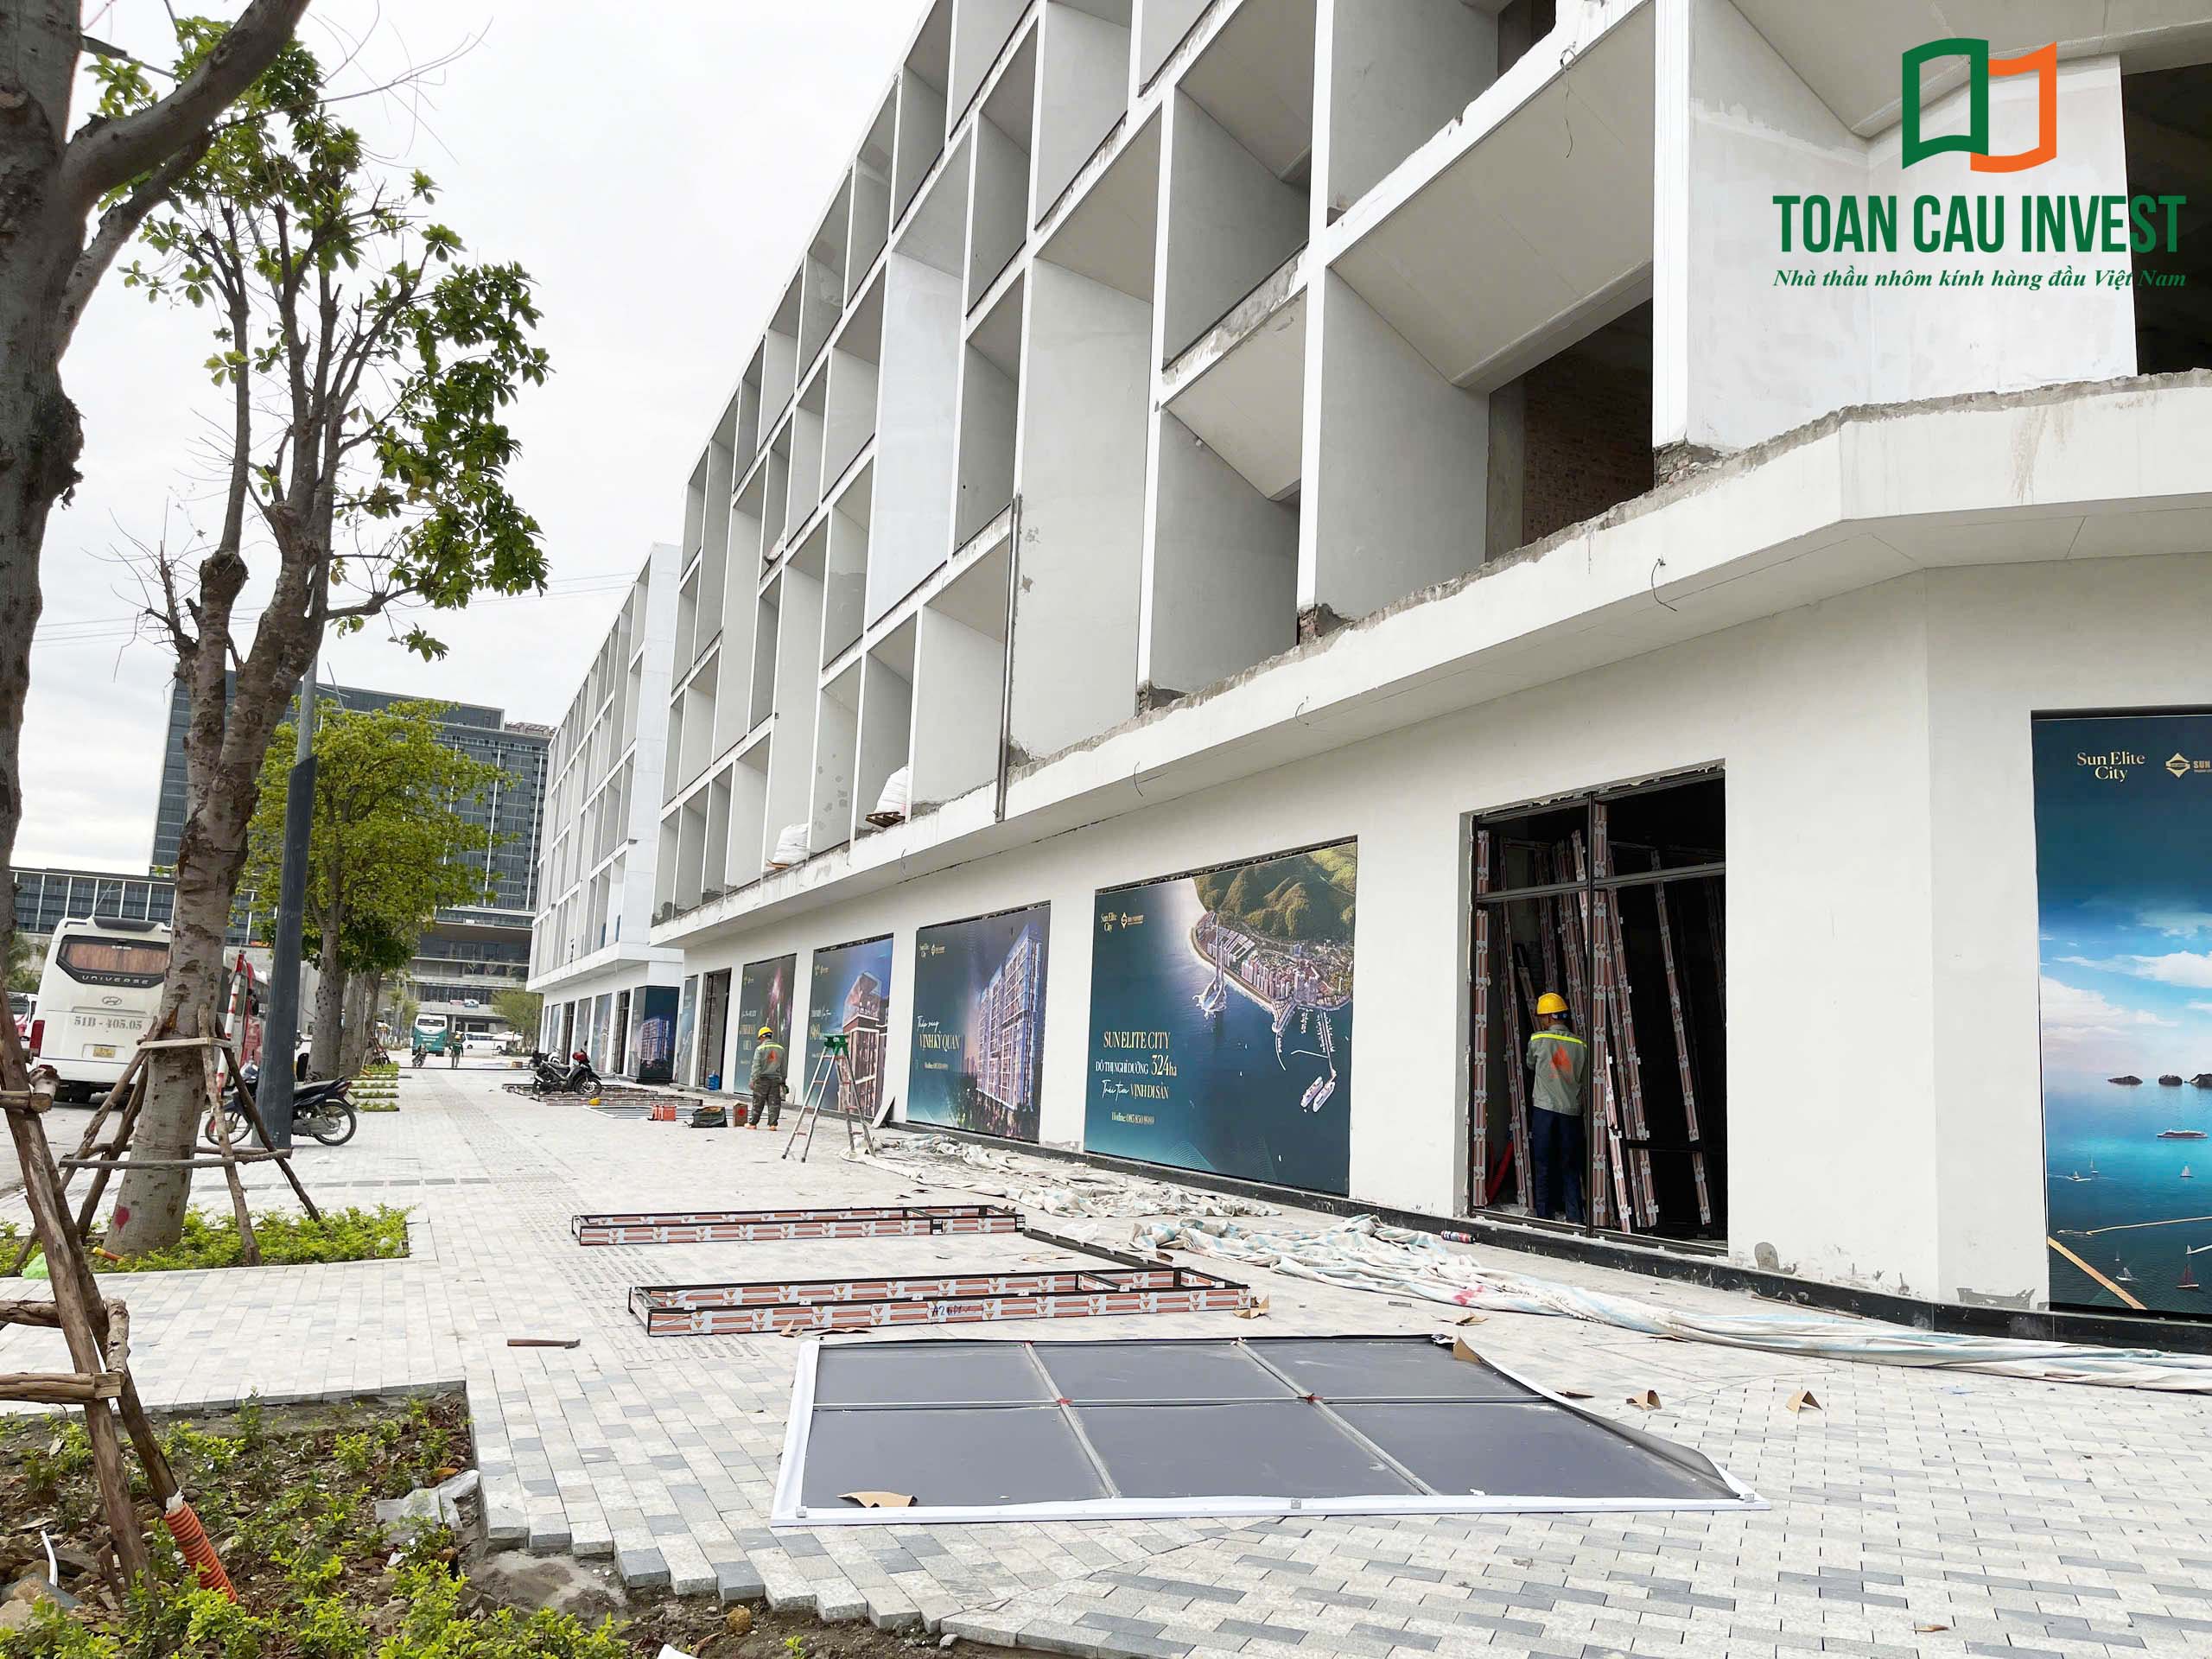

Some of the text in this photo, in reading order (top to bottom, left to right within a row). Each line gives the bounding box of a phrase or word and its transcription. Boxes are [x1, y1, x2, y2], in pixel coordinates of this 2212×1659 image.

[2076, 751, 2146, 766] Sun Elite
[2193, 760, 2211, 769] SUN
[2094, 766, 2128, 783] City
[82, 975, 149, 985] UNIVERSE
[1103, 1031, 1171, 1050] SUN ELITE CITY
